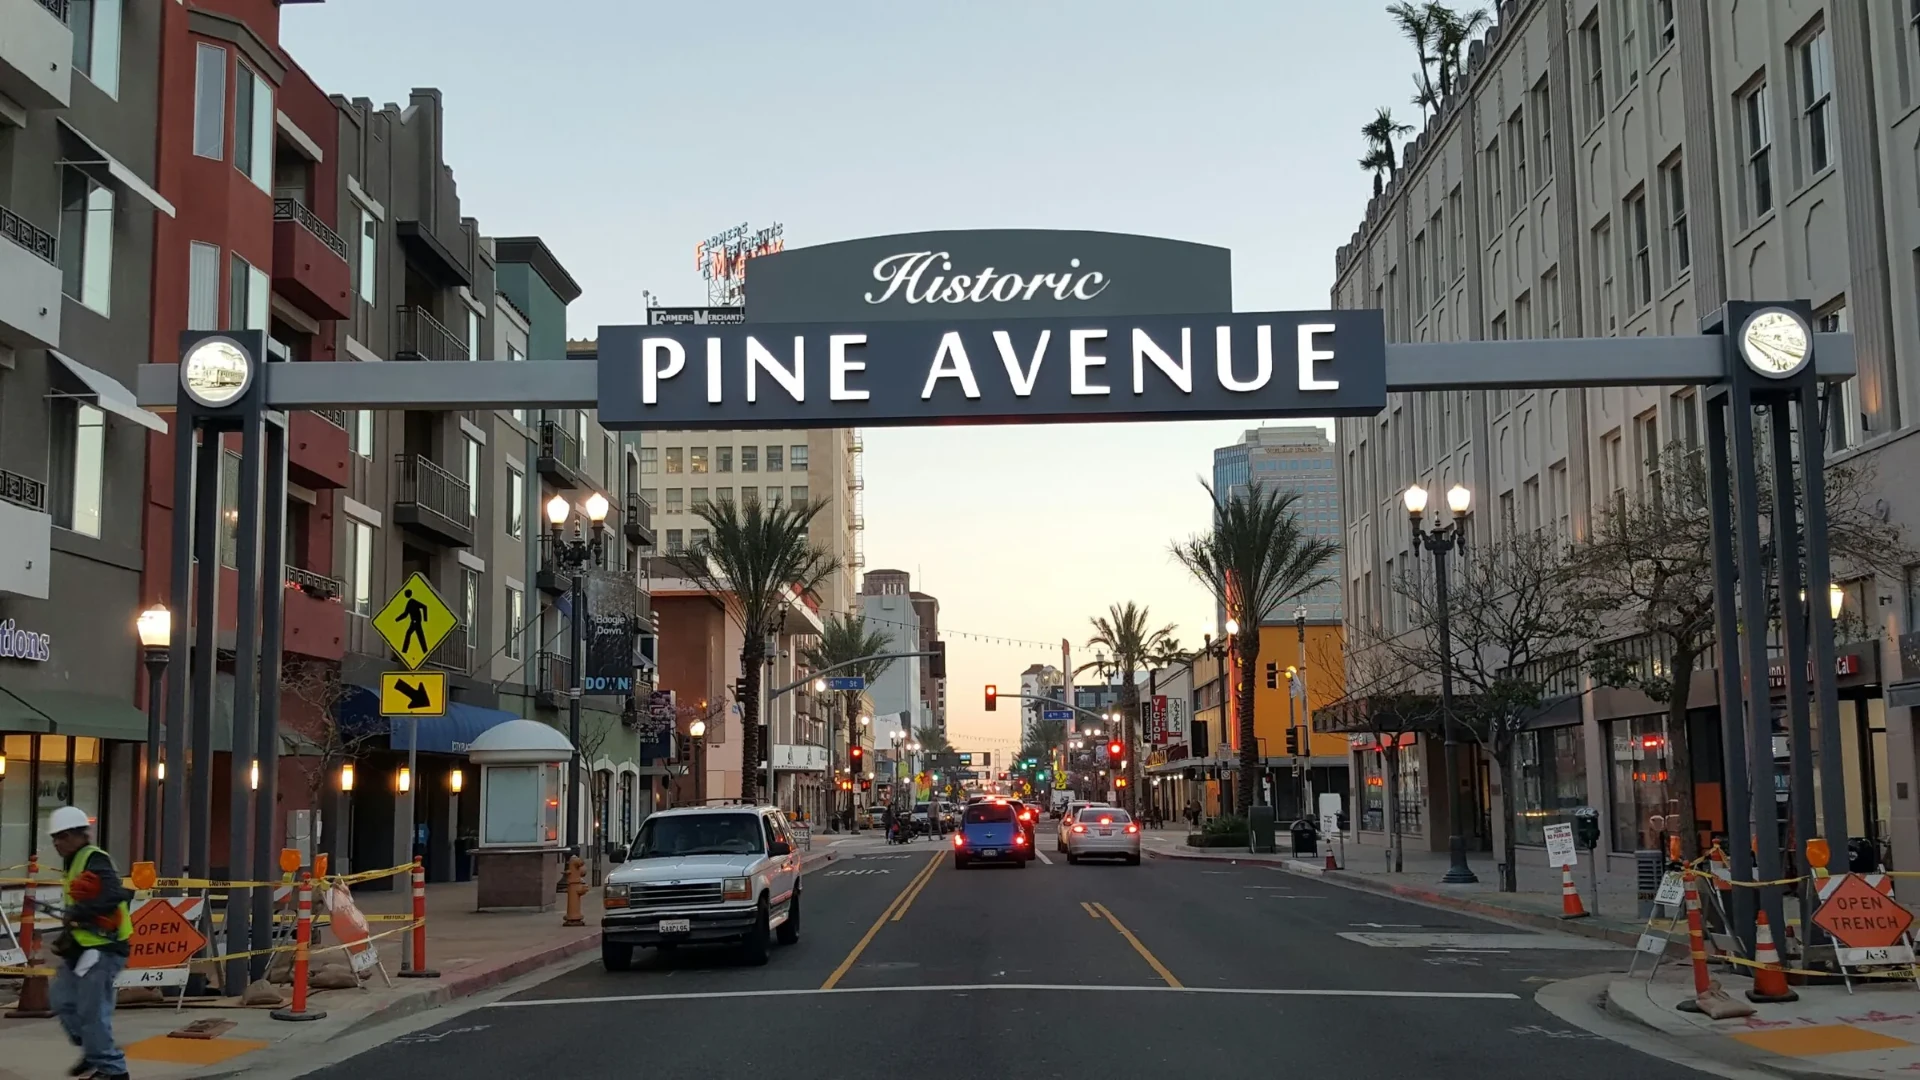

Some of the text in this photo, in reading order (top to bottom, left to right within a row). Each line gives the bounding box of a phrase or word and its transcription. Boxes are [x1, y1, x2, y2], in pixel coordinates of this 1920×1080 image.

[694, 221, 748, 271] FARMERS
[864, 251, 1112, 305] Historic
[641, 322, 1341, 405] PINE AVENUE
[596, 615, 625, 627] Boogie
[1153, 699, 1161, 740] VICTOR
[157, 879, 179, 887] CAUTION
[1837, 897, 1883, 911] OPEN
[138, 922, 181, 936] OPEN
[1831, 916, 1899, 931] TRENCH
[1866, 949, 1888, 960] A-3
[141, 970, 164, 981] A-3
